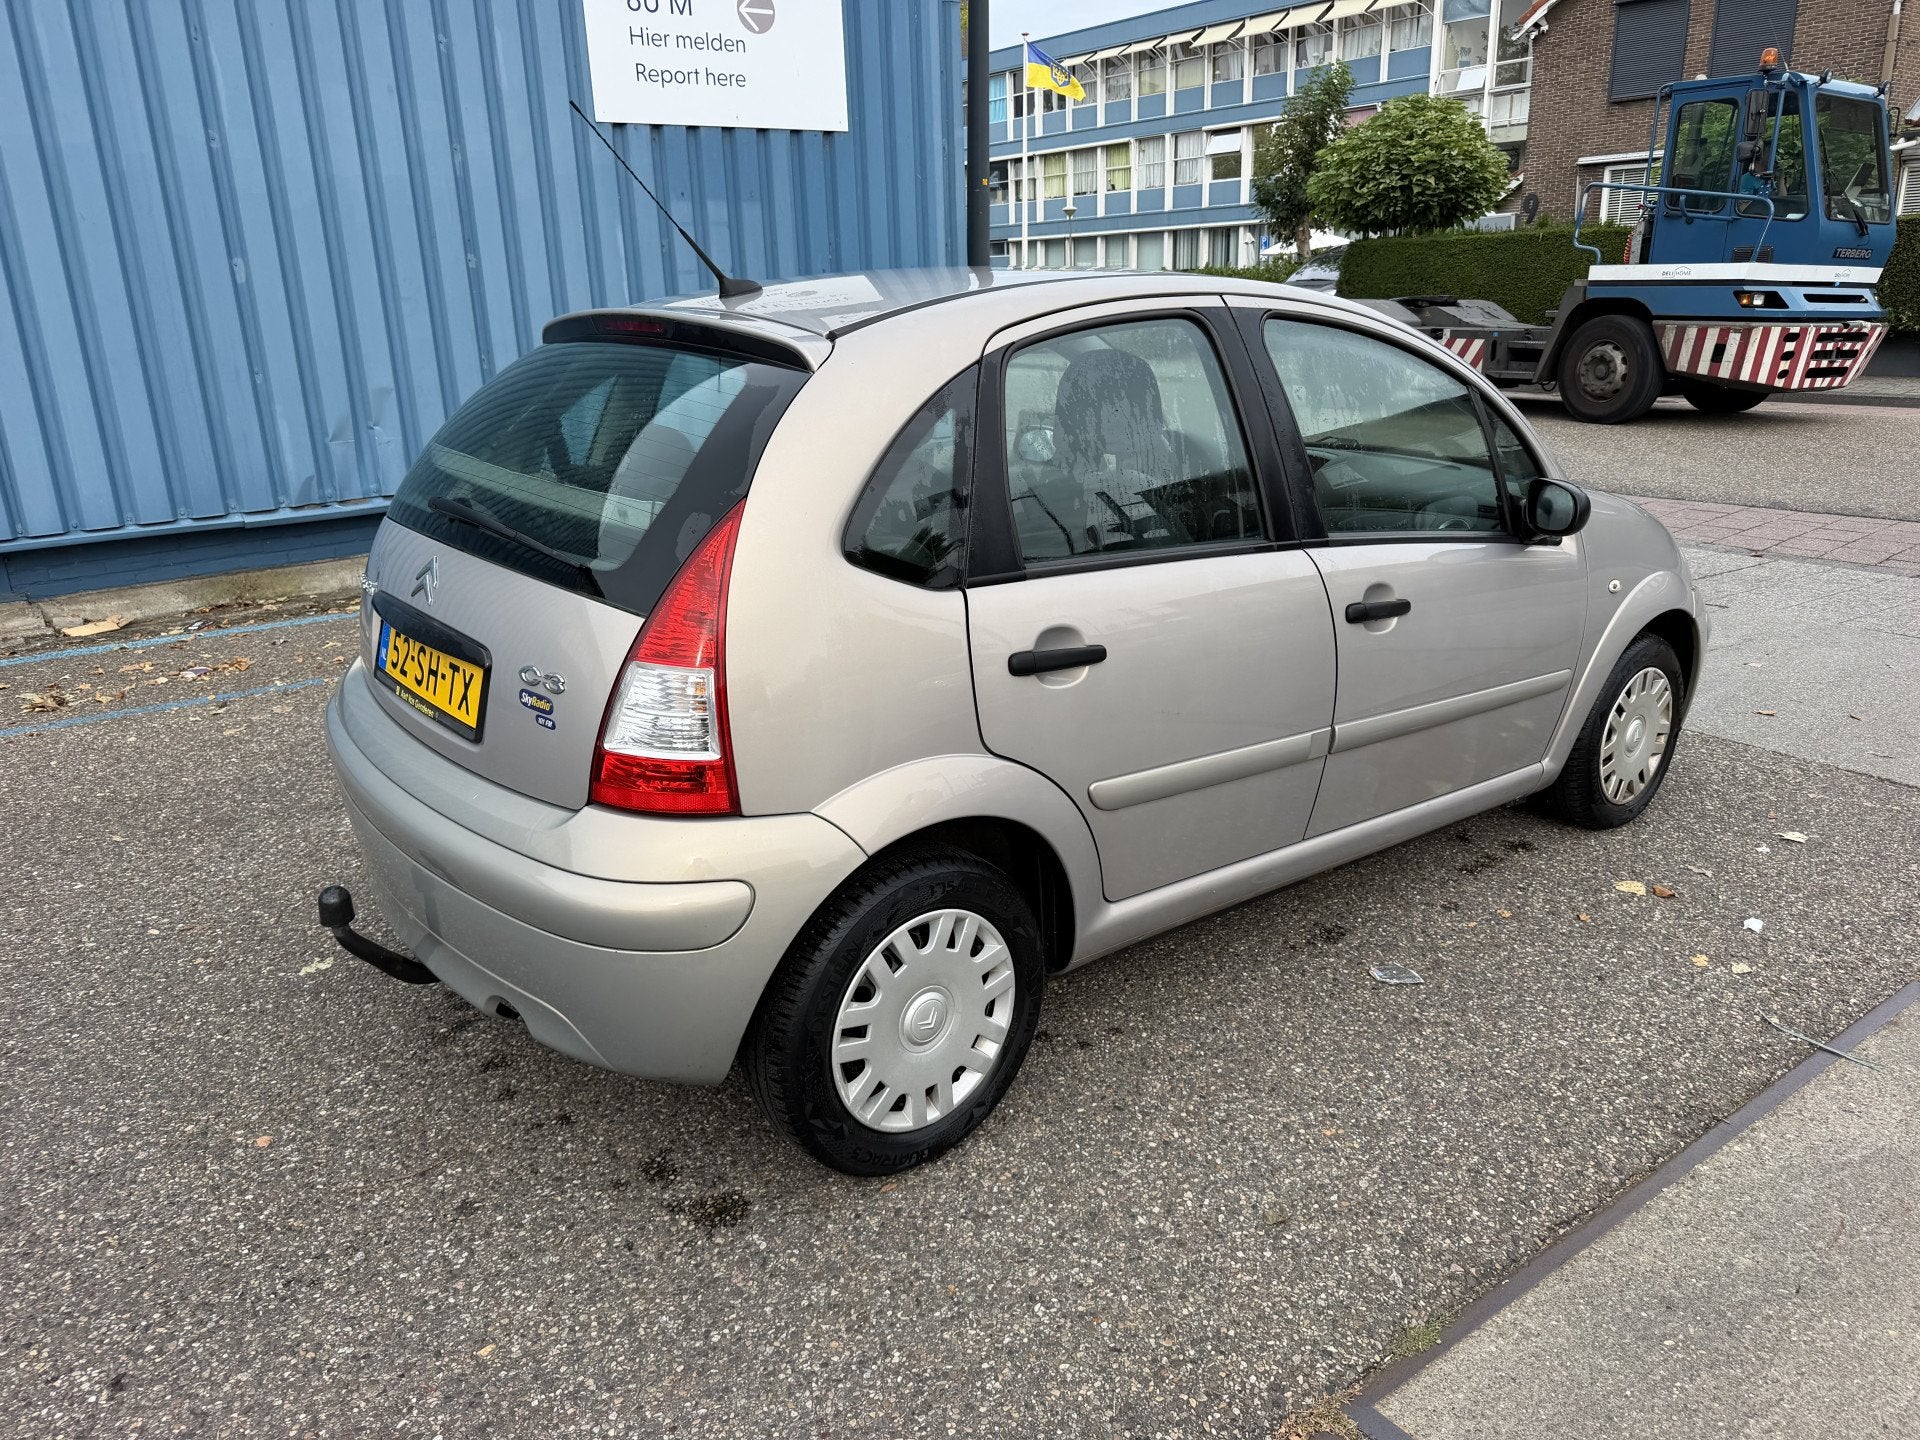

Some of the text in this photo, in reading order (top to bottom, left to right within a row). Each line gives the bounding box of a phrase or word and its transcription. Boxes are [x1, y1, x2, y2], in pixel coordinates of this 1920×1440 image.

[669, 0, 693, 16] M
[629, 26, 746, 53] Hier melden
[635, 63, 746, 88] Report here
[1836, 248, 1872, 259] TERBERG
[391, 632, 474, 716] 52-SH-TX
[518, 664, 566, 695] C3
[521, 692, 551, 711] SkyRadio
